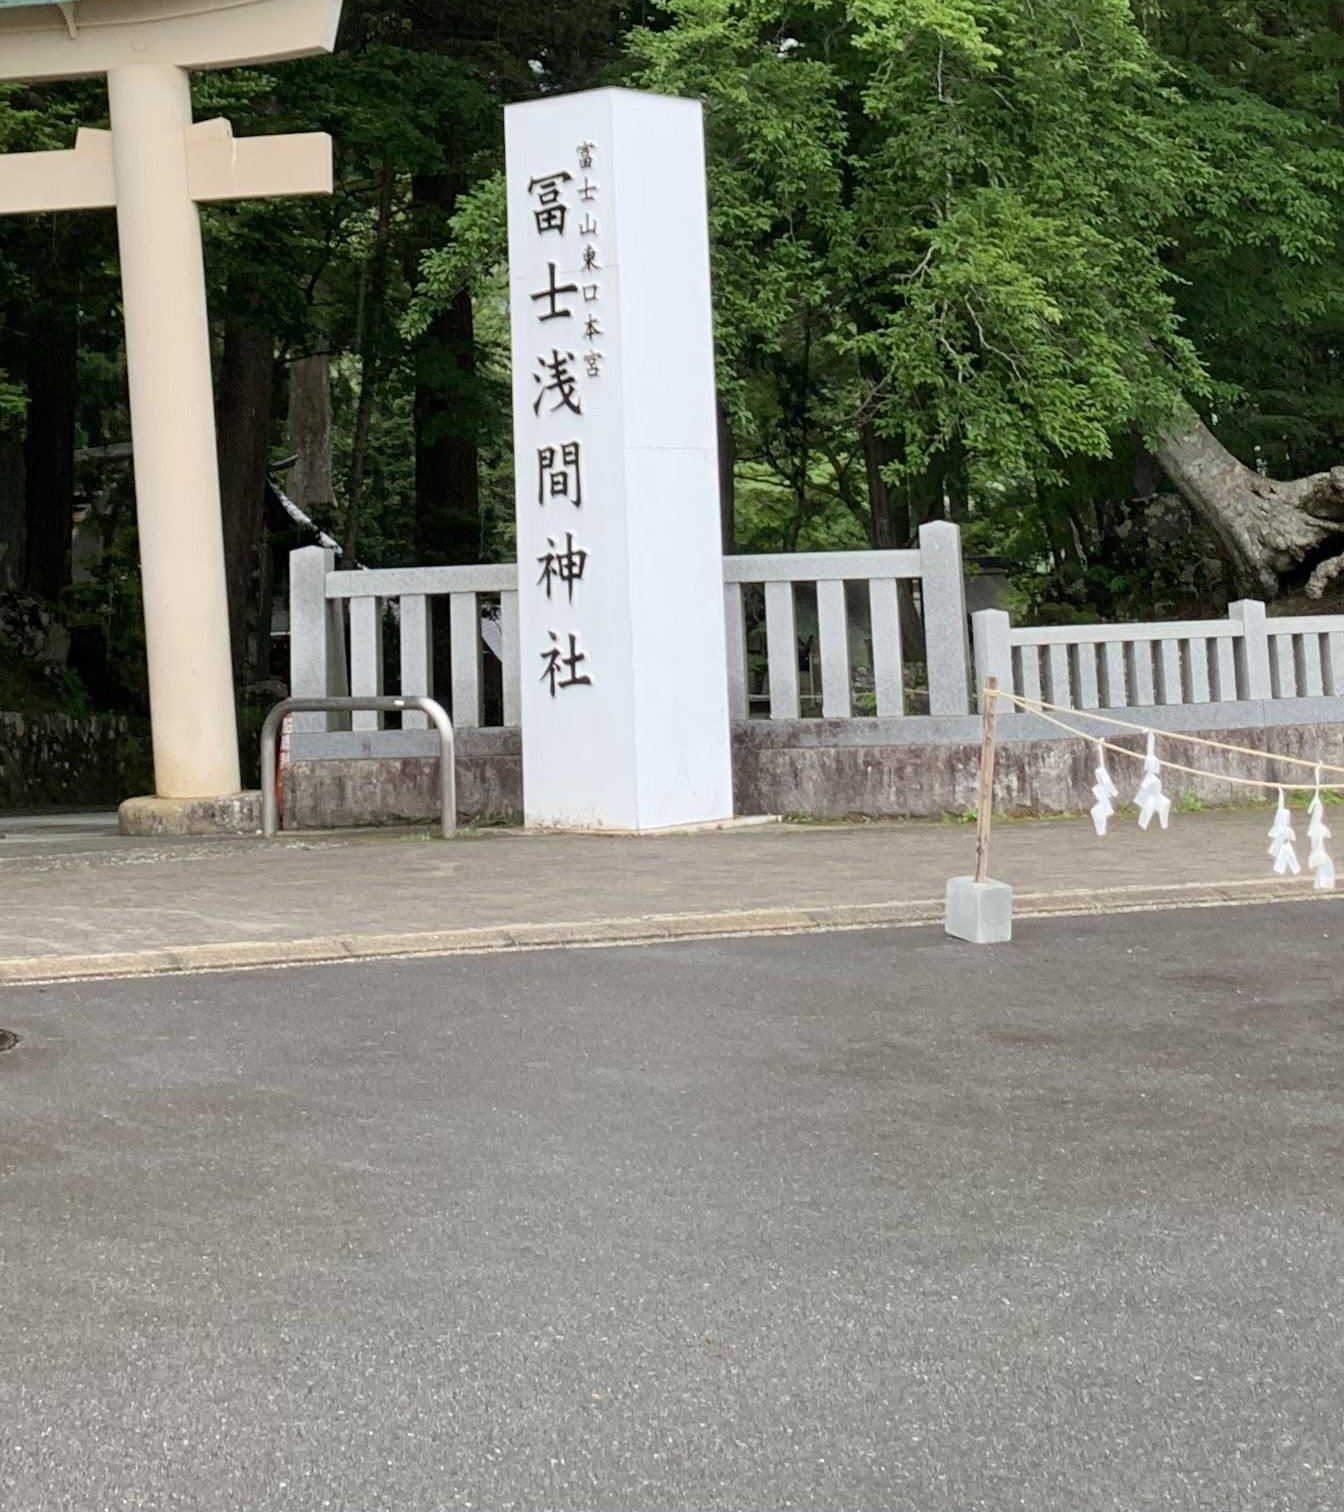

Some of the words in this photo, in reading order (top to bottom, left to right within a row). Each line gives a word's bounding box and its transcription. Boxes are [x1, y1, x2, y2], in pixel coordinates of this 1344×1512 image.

[527, 172, 592, 698] 冨士浅間神社
[576, 139, 603, 378] 富士山東口本宮
